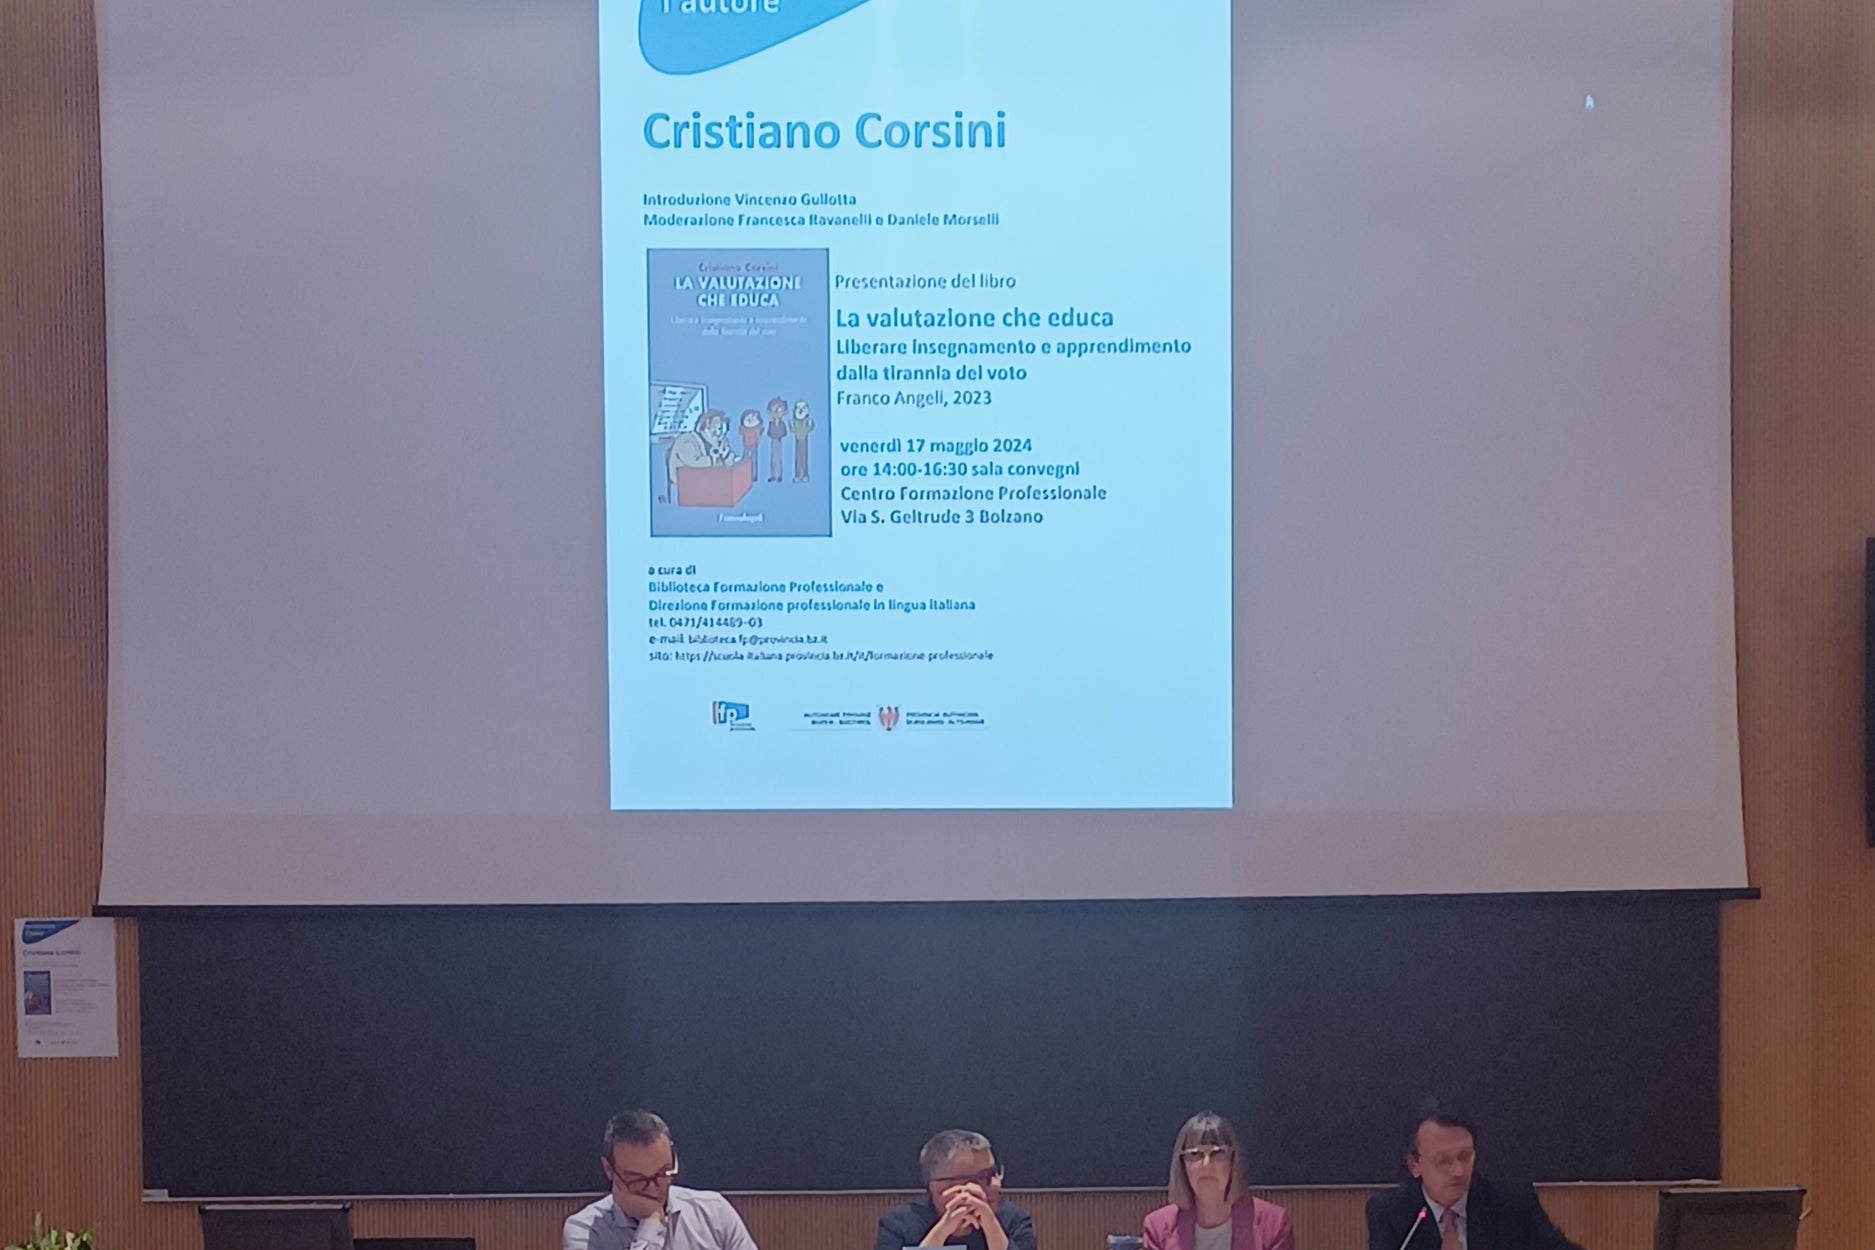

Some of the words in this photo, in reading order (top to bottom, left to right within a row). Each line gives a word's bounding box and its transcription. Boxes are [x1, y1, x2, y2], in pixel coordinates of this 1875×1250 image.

[663, 0, 780, 14] lautore
[643, 111, 840, 149] Cristiano
[856, 110, 1005, 149] Corsini
[643, 192, 731, 207] Introduzione
[735, 192, 797, 207] Vincenzo
[801, 192, 857, 207] Gullotta
[643, 213, 734, 227] Moderazione
[738, 213, 805, 227] Francesca
[809, 212, 872, 227] Ravanelli
[876, 216, 884, 227] e
[887, 212, 939, 227] Daniele
[943, 212, 1000, 227] Morselli
[675, 276, 694, 290] LA
[698, 275, 802, 291] VALUTAZIONE
[835, 274, 947, 290] Presentazione
[951, 273, 975, 289] del
[980, 273, 1016, 289] libro
[698, 293, 725, 307] CHE
[731, 293, 779, 308] EDUCA
[836, 308, 860, 328] La
[867, 307, 995, 328] valutazione
[1002, 307, 1040, 328] che
[1048, 307, 1114, 328] educa
[837, 338, 907, 356] Liberare
[913, 338, 1036, 359] insegnamento
[1041, 342, 1052, 355] e
[1057, 337, 1192, 359] apprendimento
[836, 364, 878, 381] dalla
[883, 364, 951, 381] tirannia
[956, 364, 983, 381] del
[987, 365, 1028, 381] voto
[837, 390, 890, 406] Franco
[894, 390, 948, 408] Angeli,
[953, 390, 992, 405] 2023
[840, 438, 902, 453] venerdì
[907, 438, 925, 453] 17
[930, 438, 989, 456] maggio
[993, 437, 1032, 453] 2024
[841, 464, 867, 477] ore
[873, 462, 968, 477] 14:00-16:30
[972, 461, 1003, 476] sala
[1008, 461, 1080, 480] convegni
[841, 486, 895, 501] Centro
[900, 485, 994, 501] Formazione
[999, 485, 1107, 501] Professionale
[841, 510, 867, 524] Via
[871, 510, 886, 524] S.
[890, 509, 960, 525] Geltrude
[965, 509, 975, 524] 3
[980, 509, 1044, 524] Bolzano
[658, 566, 683, 576] cura
[685, 564, 696, 576] di
[649, 581, 710, 593] Biblioteca
[713, 581, 787, 593] Formazione
[790, 580, 873, 593] Professionale
[876, 583, 884, 593] e
[649, 599, 708, 612] Direzione
[711, 599, 784, 612] Formazione
[787, 598, 871, 614] professionale
[873, 599, 885, 611] in
[889, 598, 926, 614] lingua
[929, 598, 976, 611] italiana
[649, 617, 666, 628] tel.
